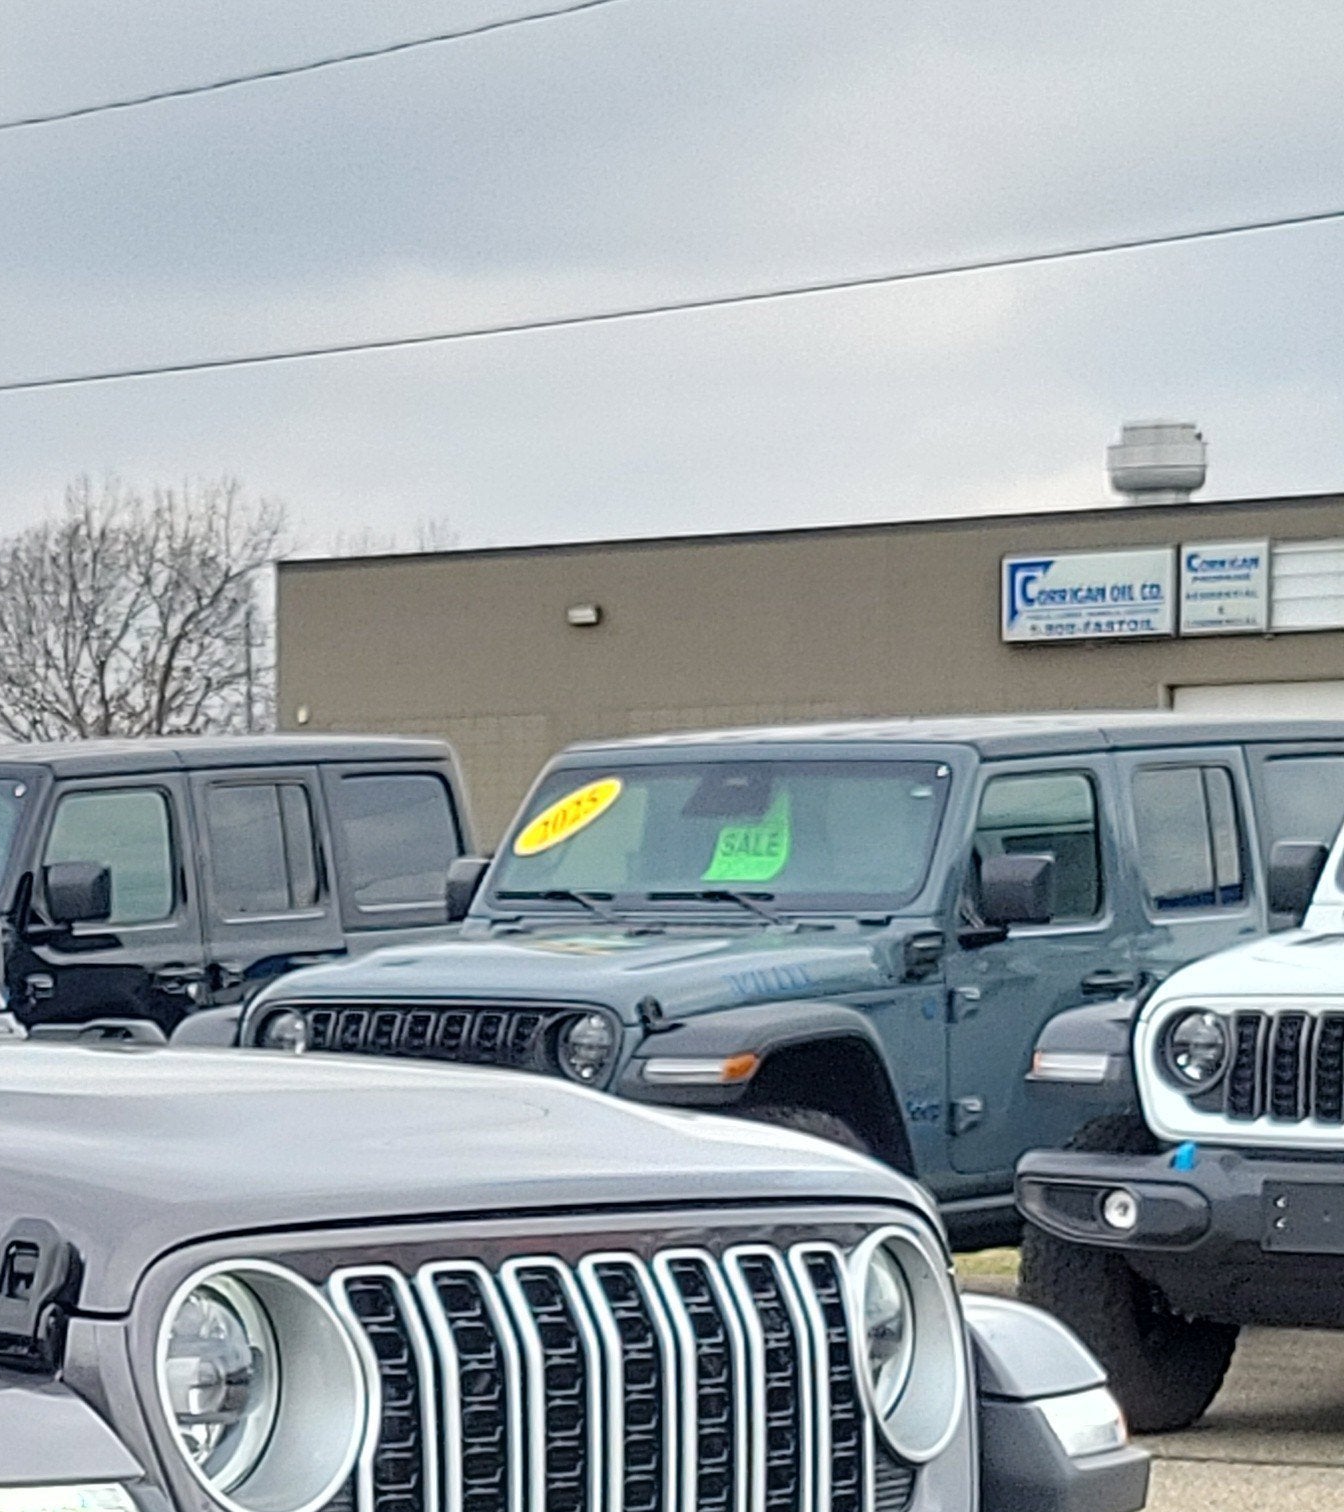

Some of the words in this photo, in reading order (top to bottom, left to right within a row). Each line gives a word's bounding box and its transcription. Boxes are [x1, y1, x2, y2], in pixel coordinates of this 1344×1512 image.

[1020, 574, 1107, 606] CORRIGAN
[1110, 584, 1134, 602] OIL
[720, 831, 780, 858] SALE
